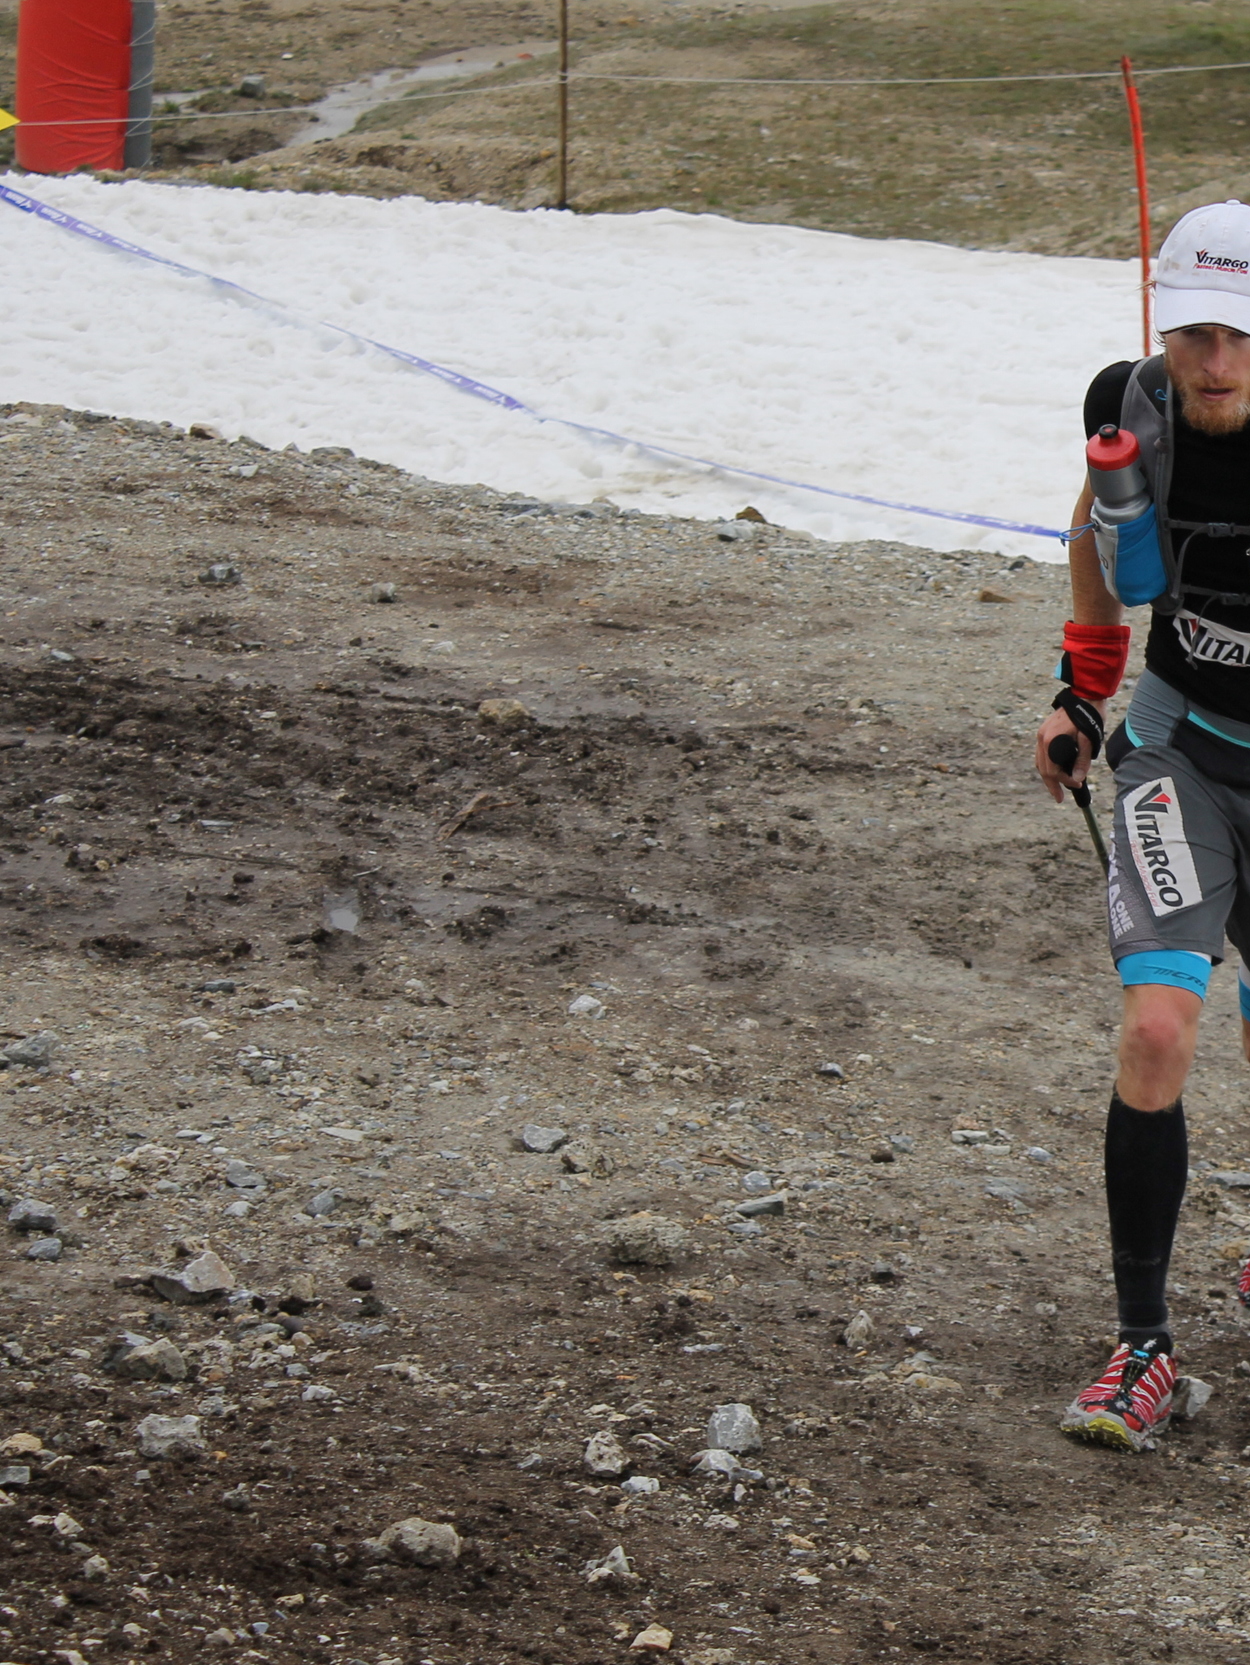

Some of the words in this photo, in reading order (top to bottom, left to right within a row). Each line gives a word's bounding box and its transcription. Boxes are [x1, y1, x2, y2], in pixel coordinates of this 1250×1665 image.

[1195, 249, 1249, 269] VITARGO
[1134, 783, 1183, 907] VITARGO
[1110, 907, 1124, 939] ONE
[1116, 900, 1135, 933] ONE
